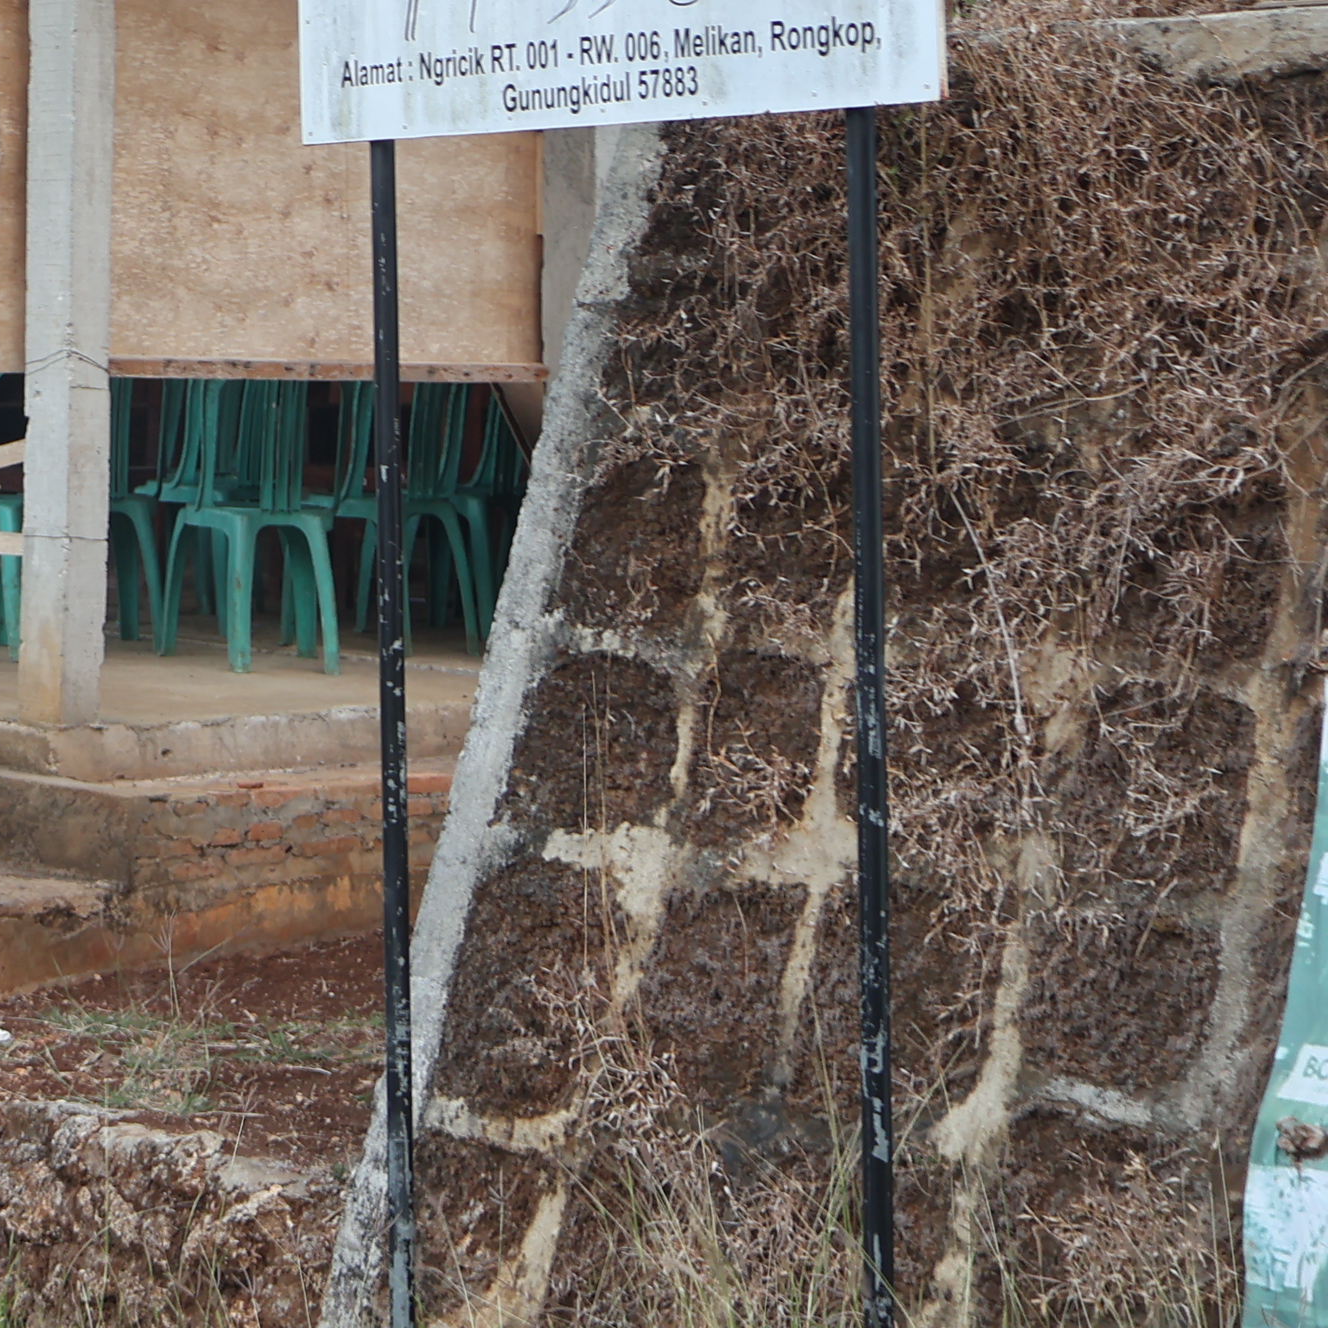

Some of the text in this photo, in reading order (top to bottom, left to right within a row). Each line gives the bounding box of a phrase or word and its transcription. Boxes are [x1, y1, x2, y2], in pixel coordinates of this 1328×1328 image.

[417, 46, 486, 87] Ngricik
[490, 42, 521, 74] RT.
[526, 38, 560, 70] 001
[579, 33, 619, 66] RW.
[624, 29, 670, 64] 006,
[673, 25, 764, 58] Melikan,
[769, 15, 882, 57] Rongkop,
[502, 65, 699, 115] Gunungkidul 57883
